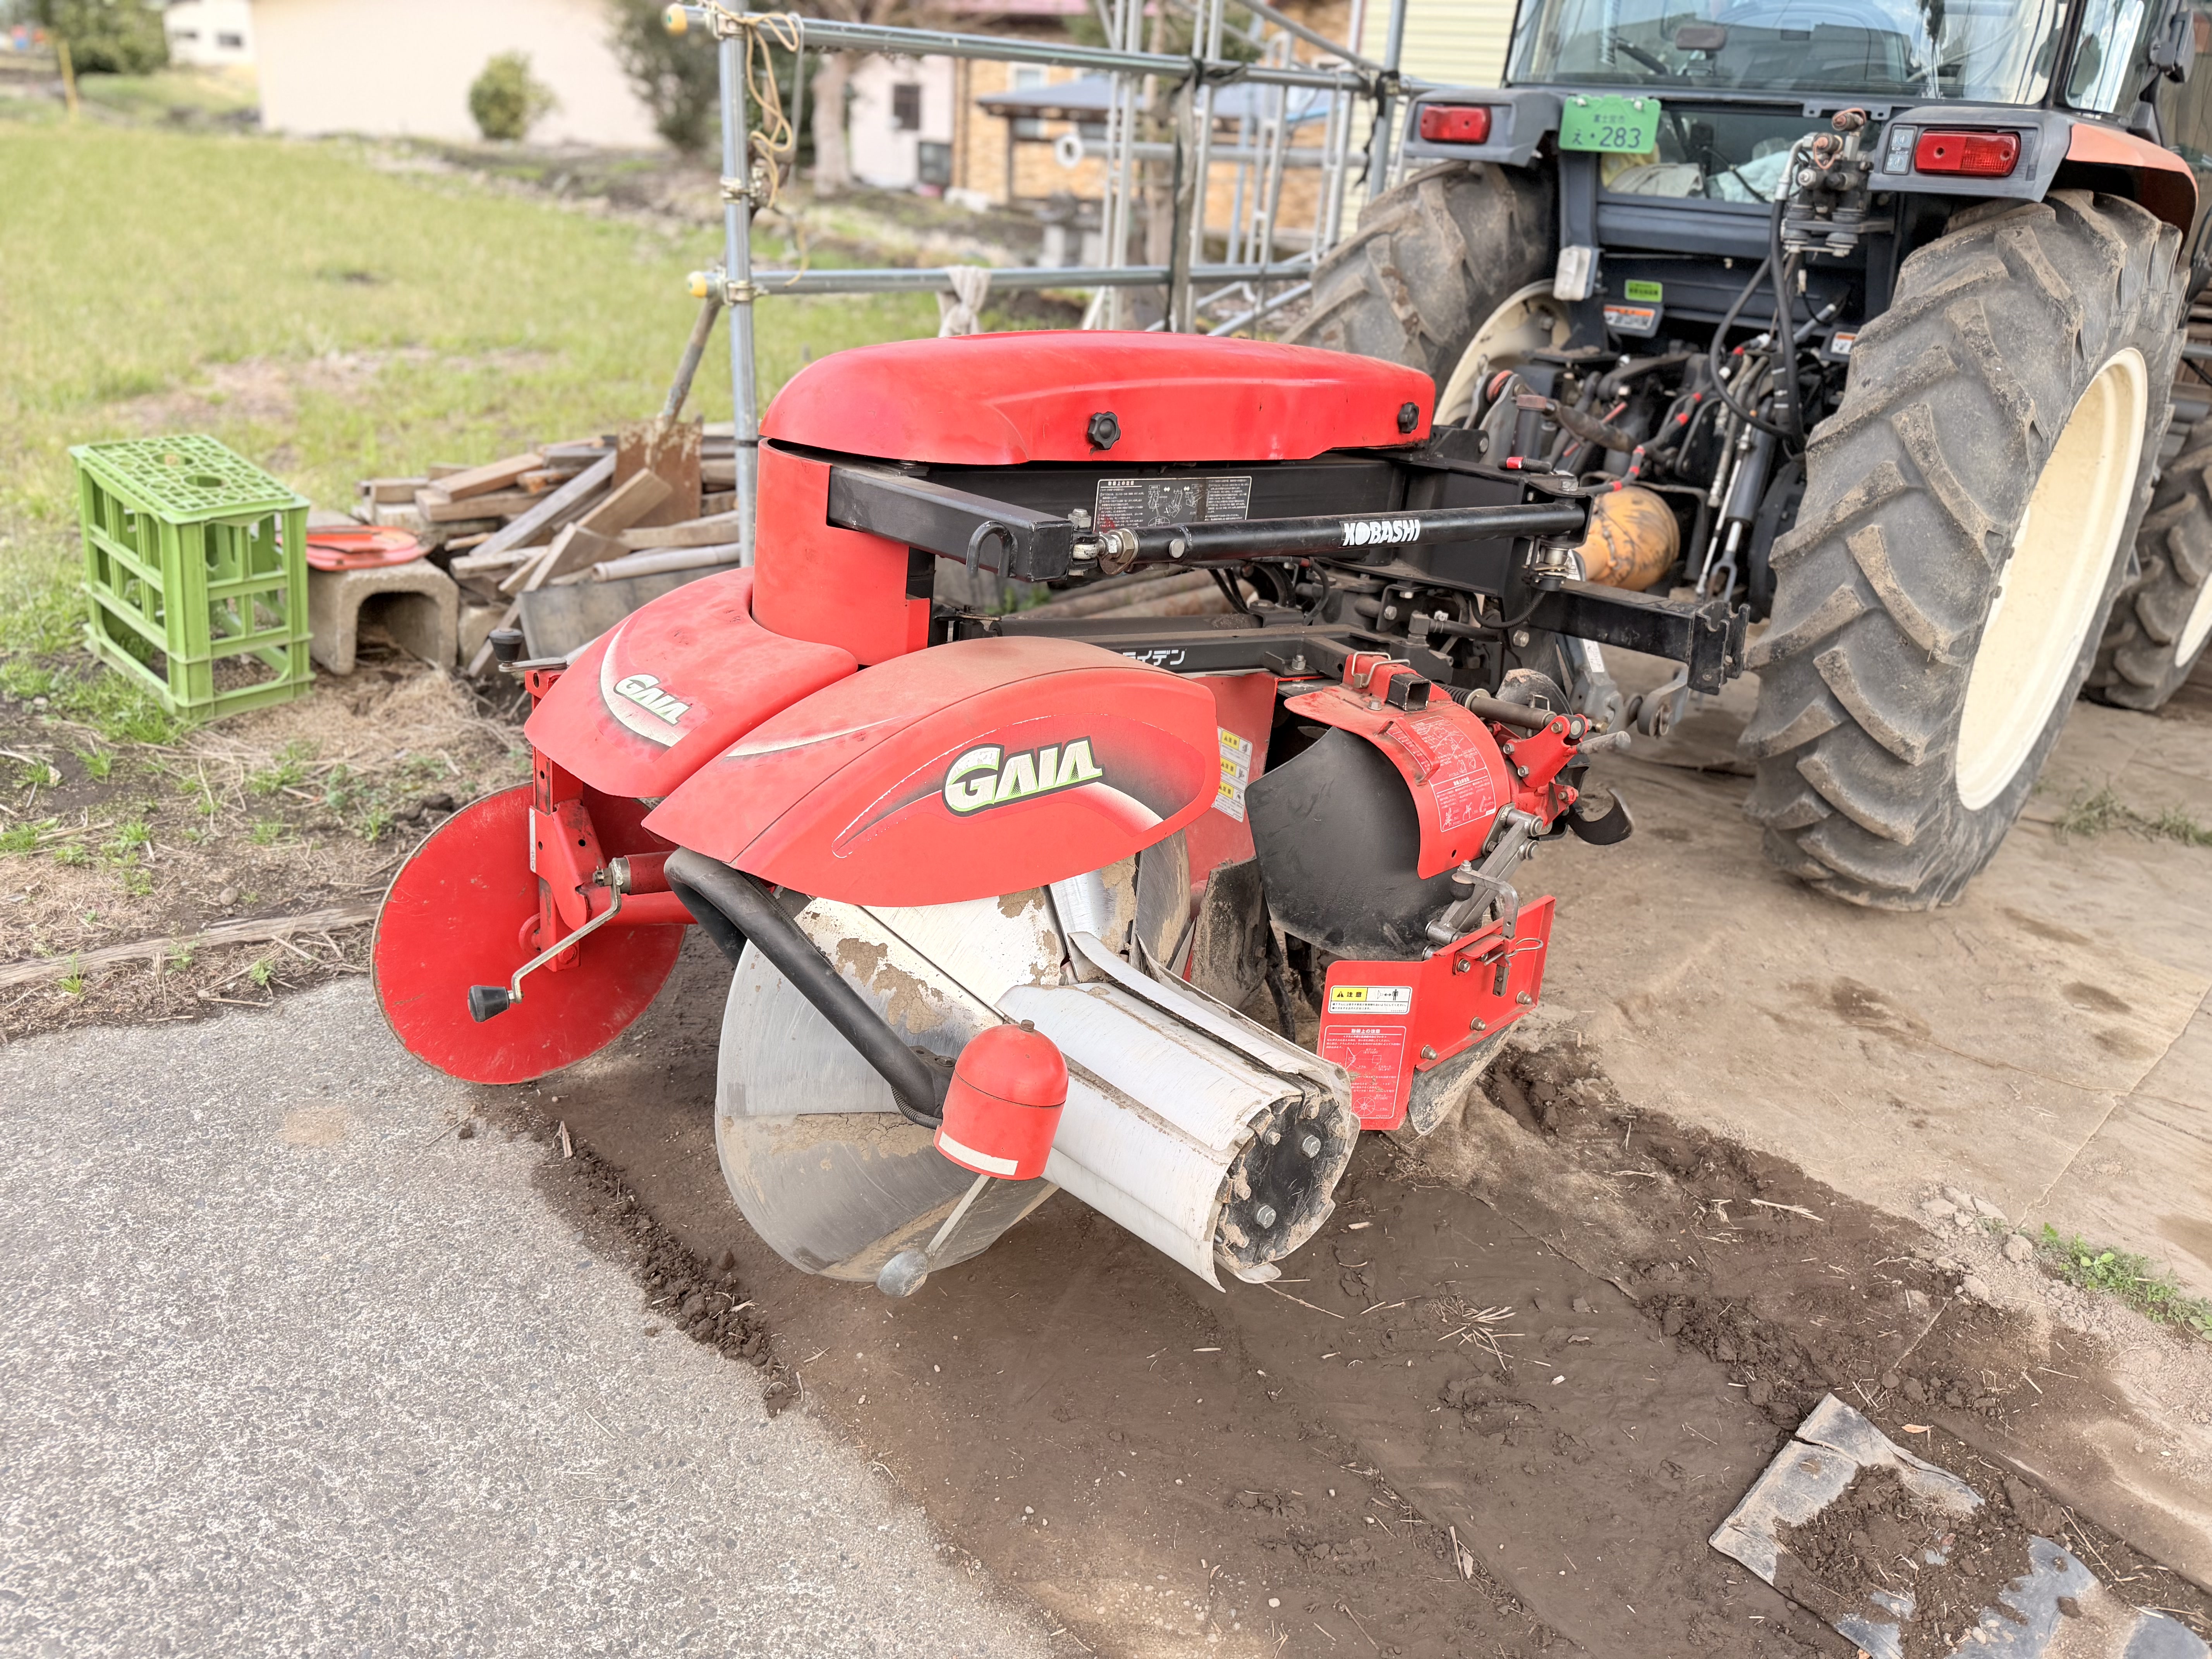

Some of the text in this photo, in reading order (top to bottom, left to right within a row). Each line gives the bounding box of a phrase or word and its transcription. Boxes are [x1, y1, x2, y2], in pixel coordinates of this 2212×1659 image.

[1342, 519, 1420, 546] KOBASHI
[615, 674, 690, 725] GAIA
[944, 740, 1103, 812] GAIA
